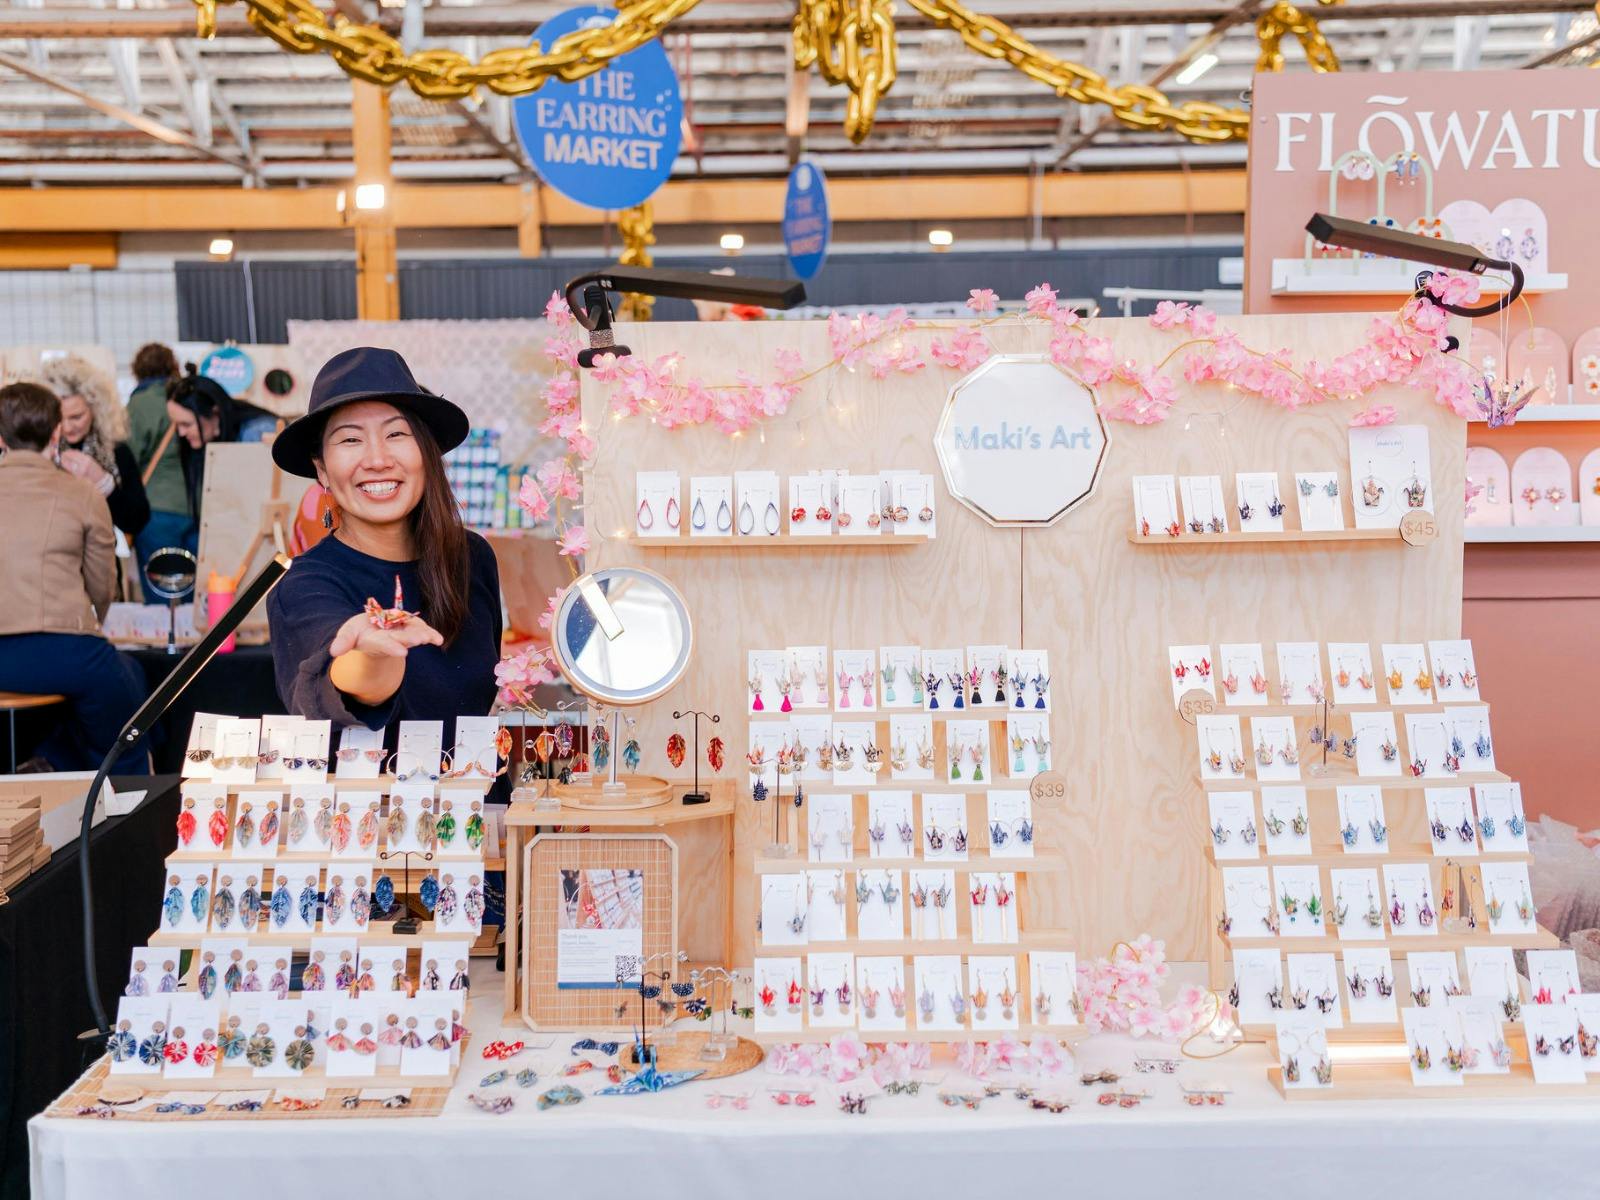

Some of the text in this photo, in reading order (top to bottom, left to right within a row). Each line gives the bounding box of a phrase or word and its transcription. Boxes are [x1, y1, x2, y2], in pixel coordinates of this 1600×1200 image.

[577, 70, 636, 101] THE
[536, 98, 667, 138] EARRING
[543, 131, 663, 171] MARKET
[954, 421, 1092, 450] Maki's Art
[1403, 520, 1435, 537] $45
[1183, 699, 1213, 715] $35
[1034, 782, 1065, 799] $39
